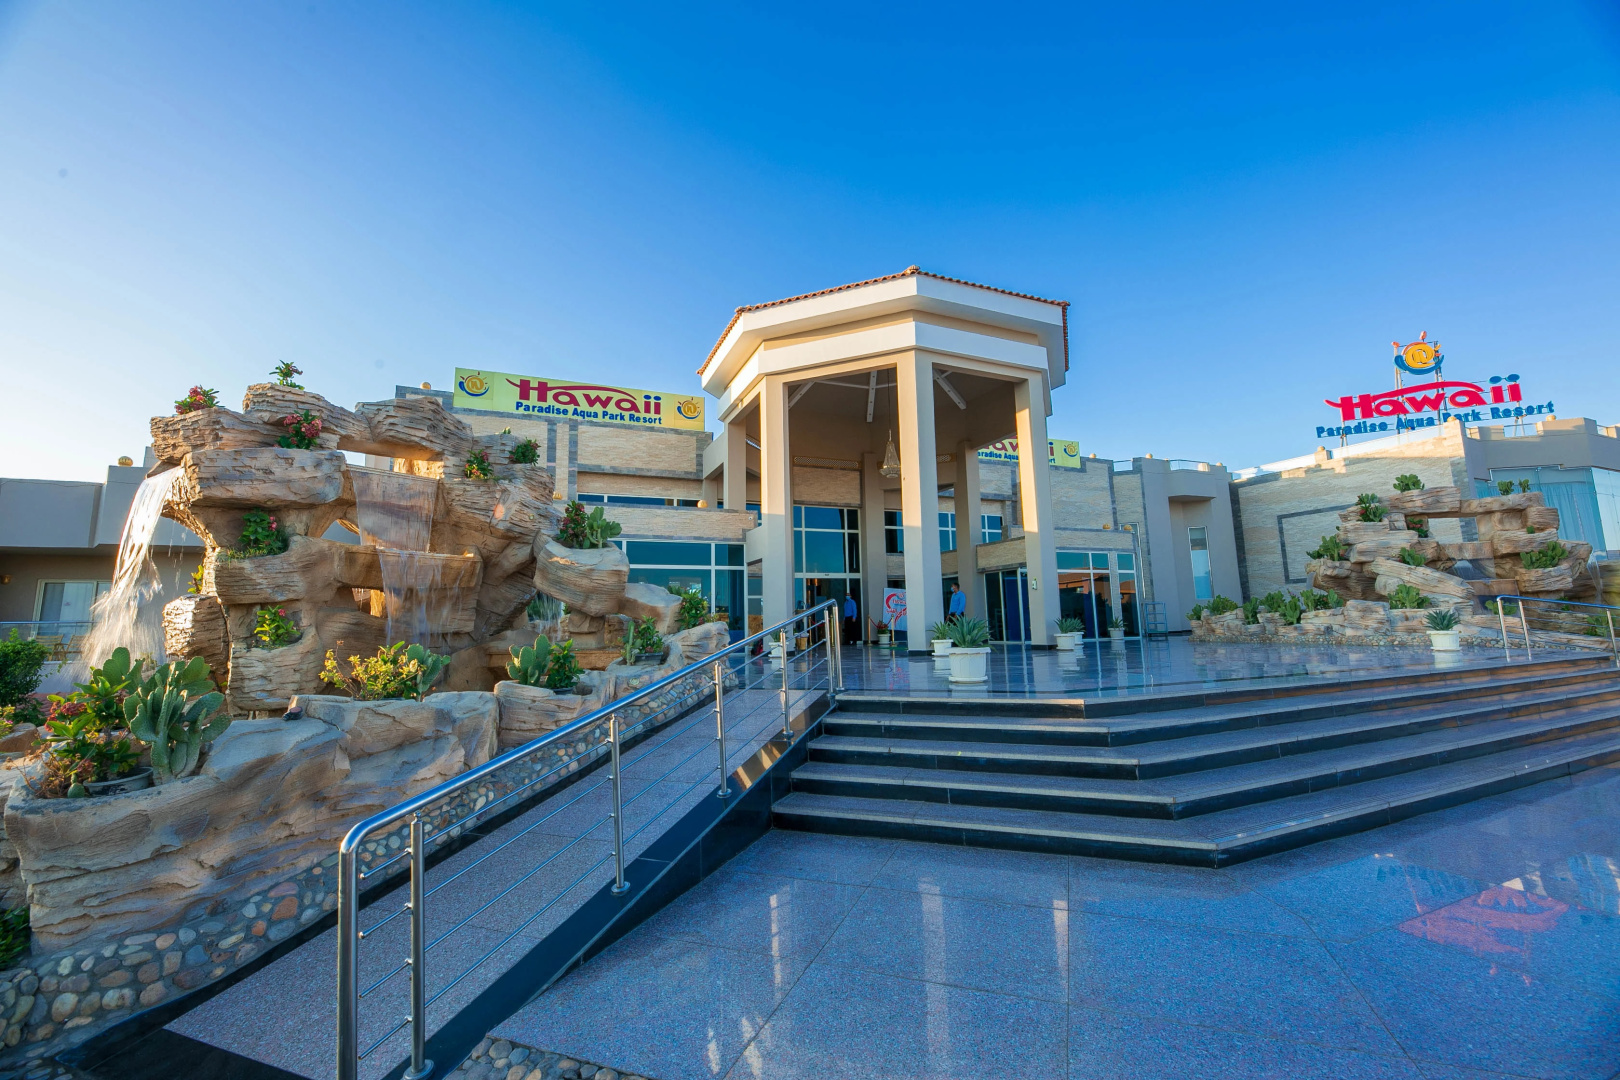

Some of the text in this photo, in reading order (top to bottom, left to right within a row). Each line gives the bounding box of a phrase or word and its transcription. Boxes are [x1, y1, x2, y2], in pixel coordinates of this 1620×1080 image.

[506, 378, 661, 415] Hawaii
[515, 401, 662, 425] Paradise Aqua Park Resort
[1324, 373, 1523, 421] Hawaii
[1316, 420, 1389, 438] Paradise
[1396, 417, 1436, 431] Aqua
[1490, 400, 1555, 419] Resort
[977, 450, 1003, 459] aradise
